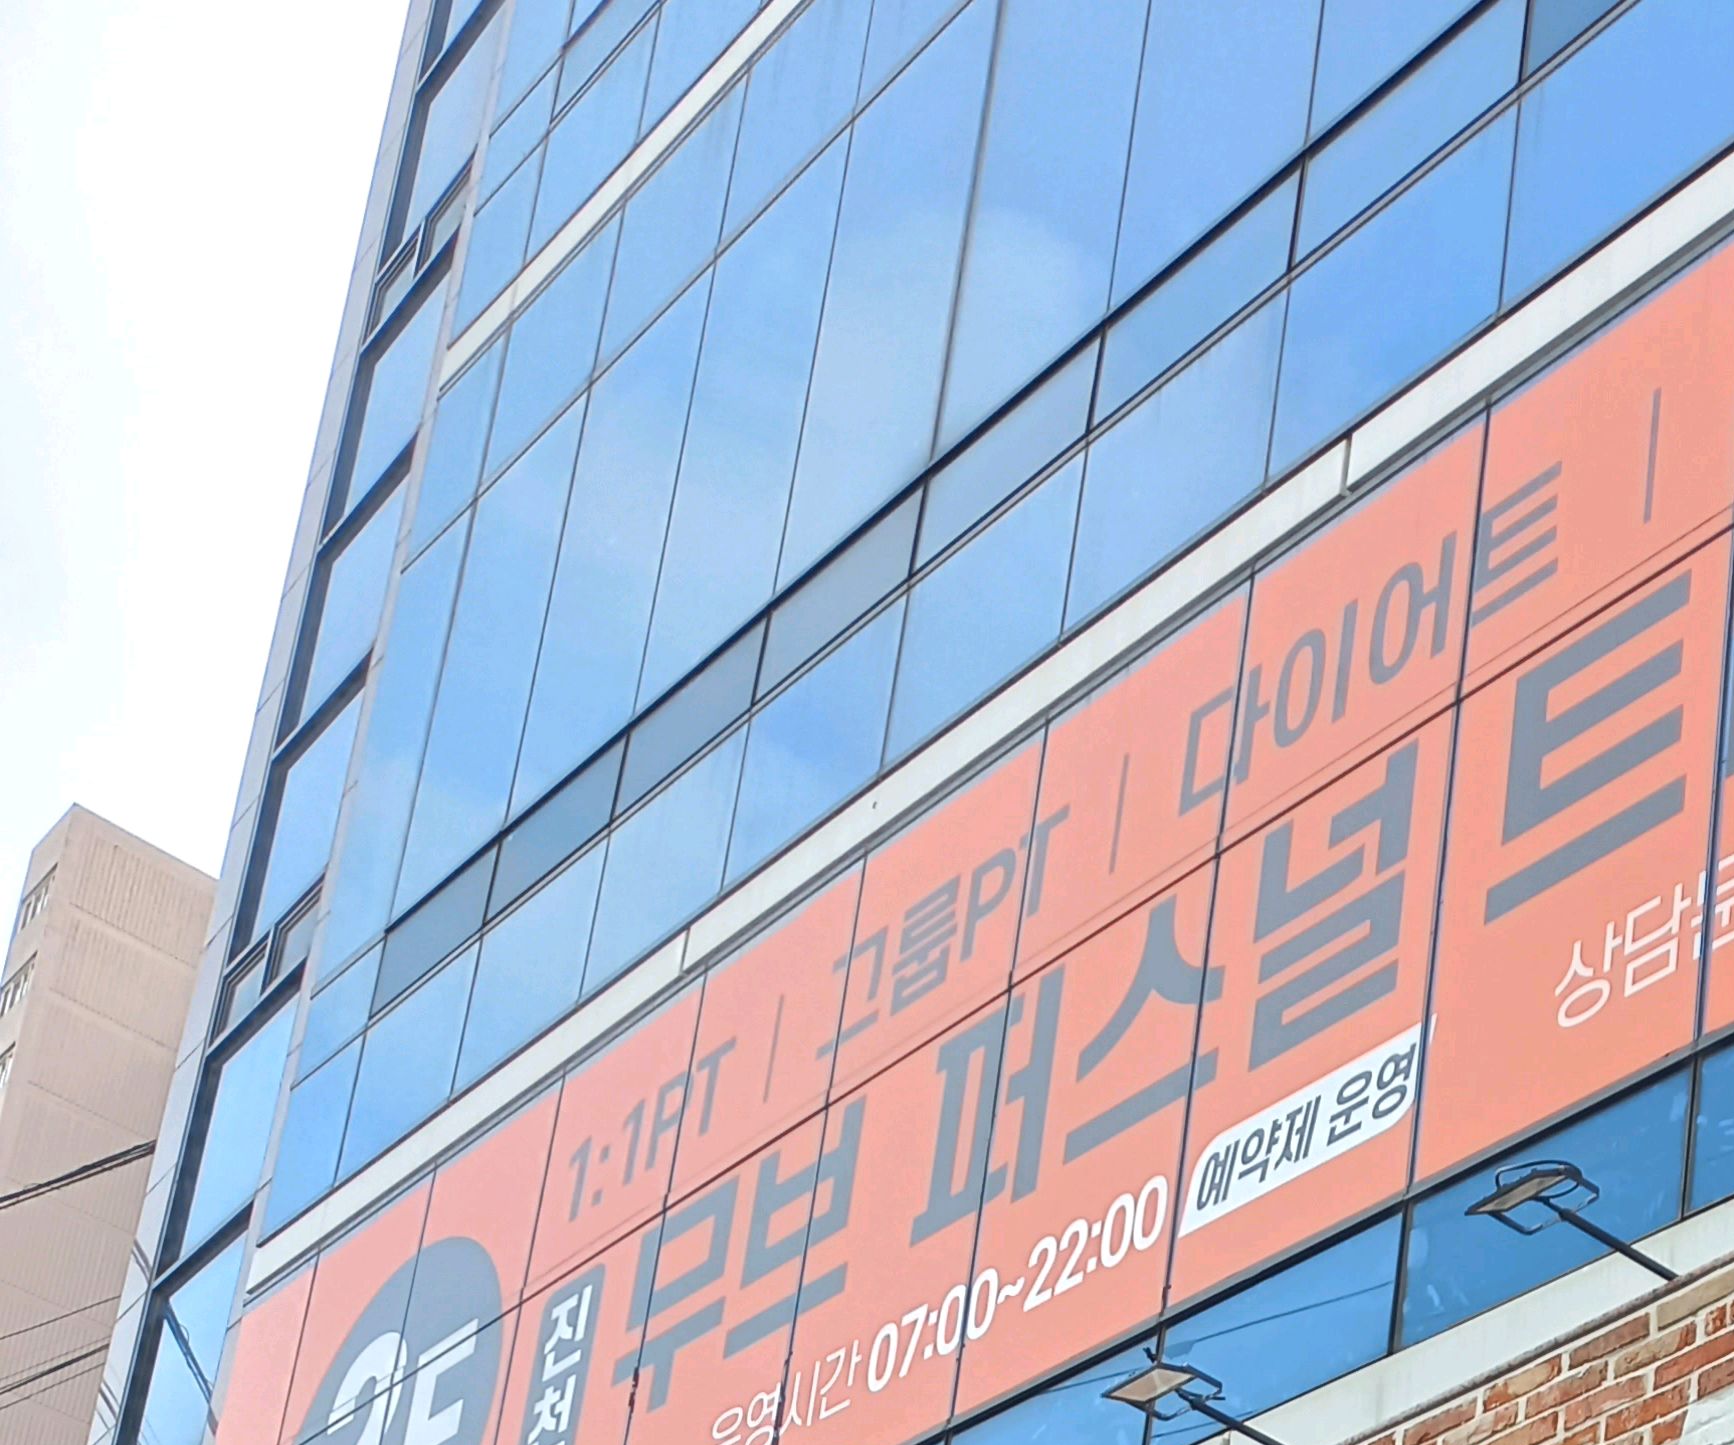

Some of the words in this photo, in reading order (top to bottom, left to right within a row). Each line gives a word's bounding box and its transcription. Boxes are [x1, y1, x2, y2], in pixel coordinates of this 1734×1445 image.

[567, 1036, 737, 1223] 1:1PT
[816, 804, 1070, 1060] 그룹PT
[1178, 460, 1563, 816] 다이어트
[611, 1094, 867, 1413] 무브
[910, 738, 1419, 1248] 퍼스널
[866, 1174, 1171, 1394] 07:00~22:00
[1197, 1097, 1320, 1211] 예약제
[1326, 1042, 1417, 1142] 운영
